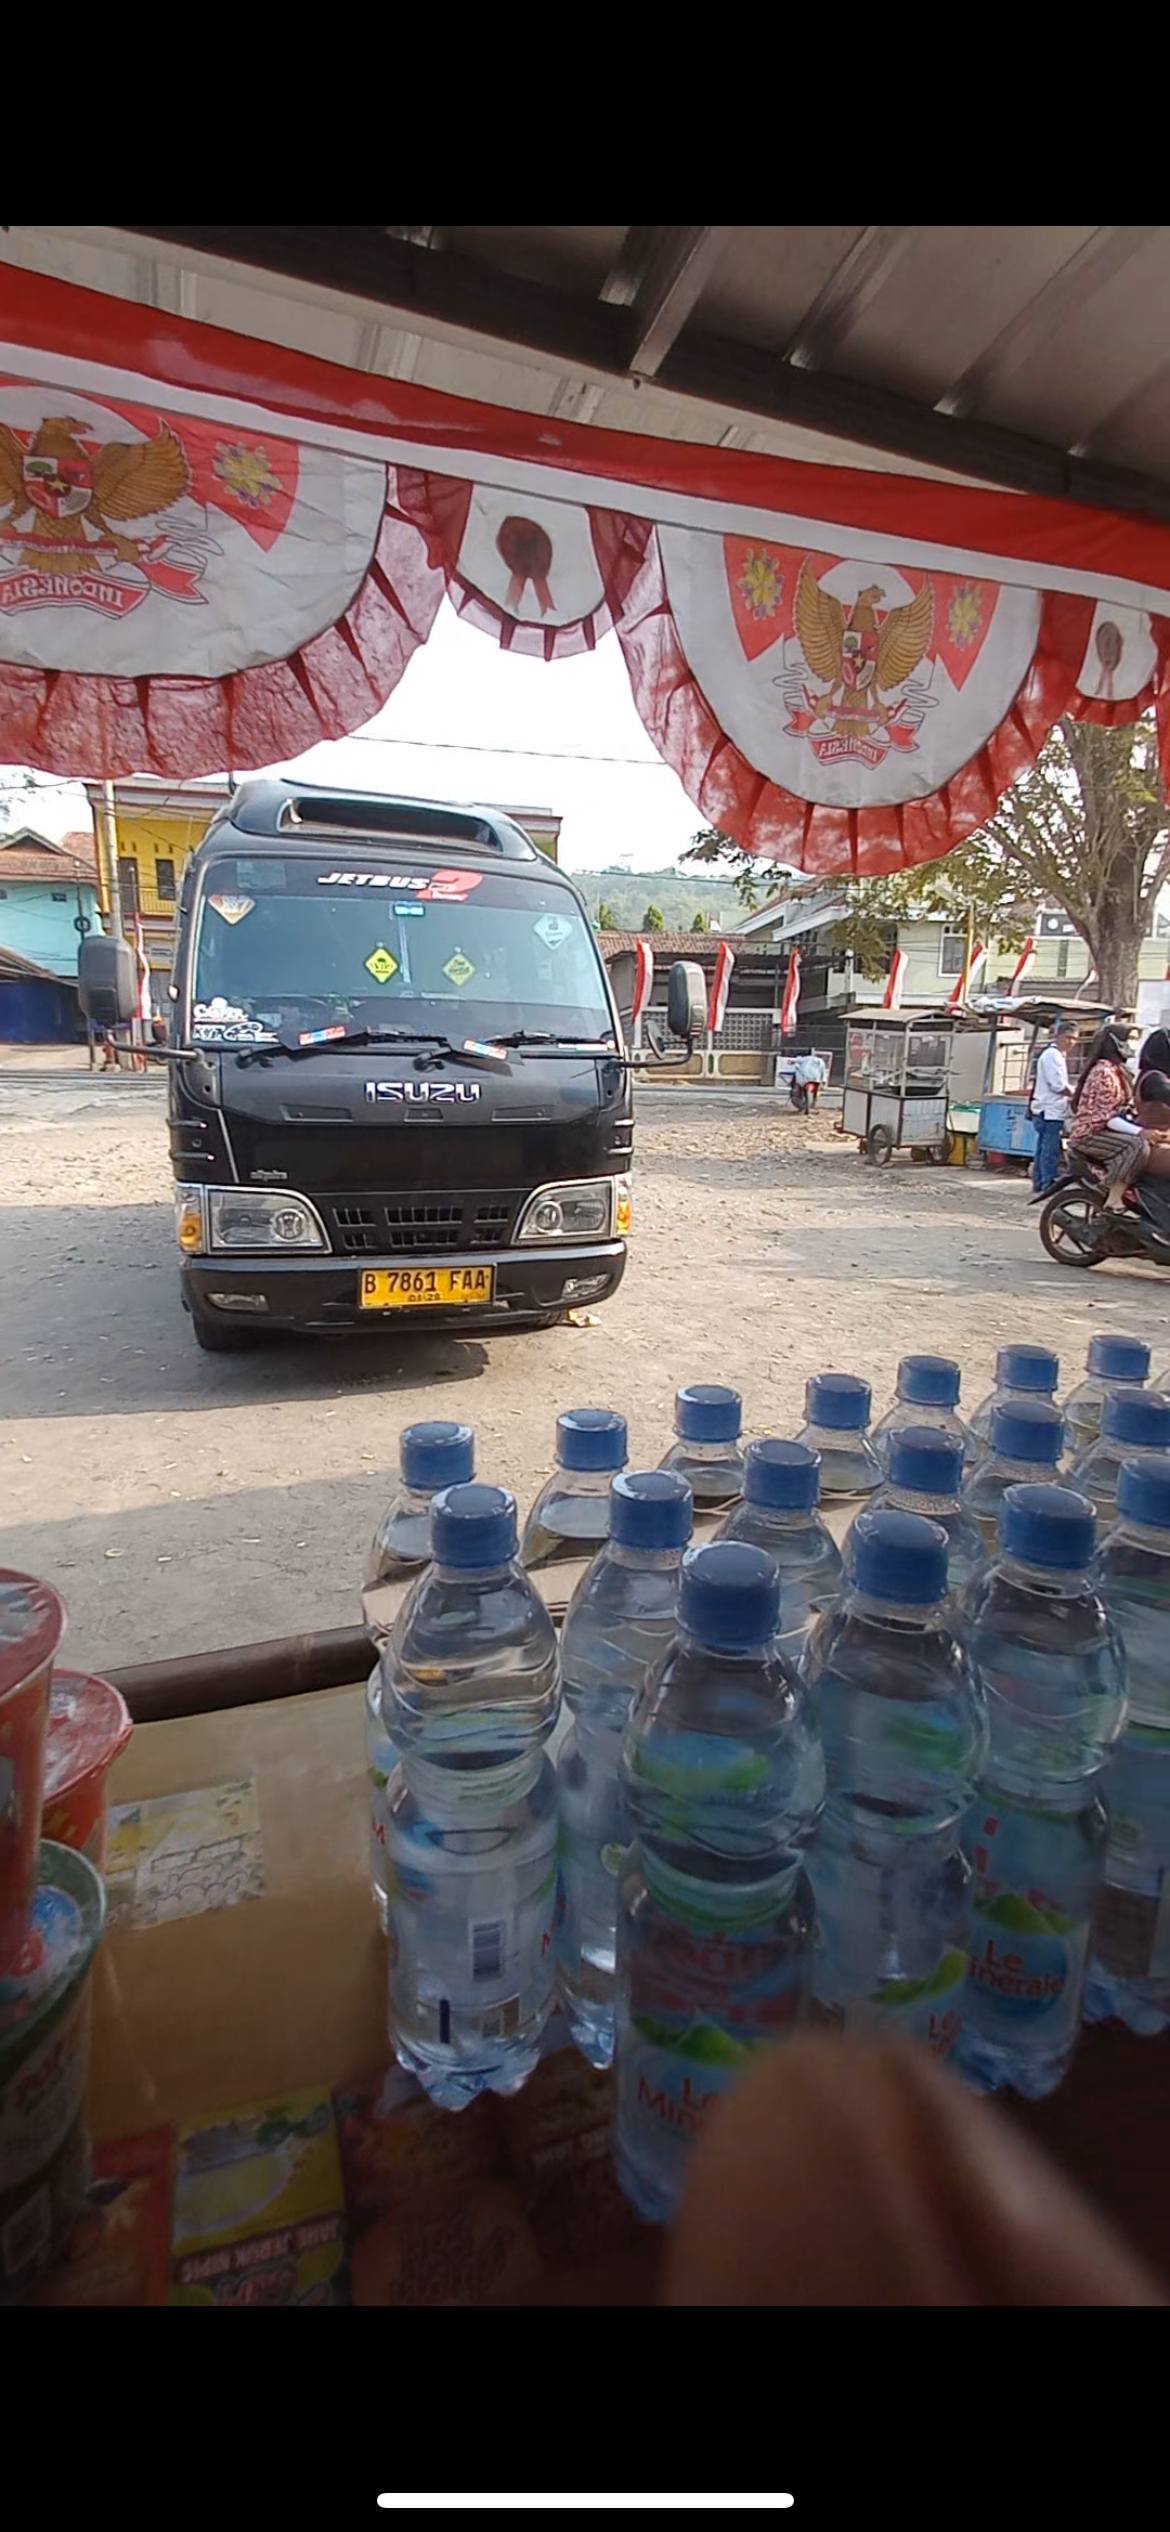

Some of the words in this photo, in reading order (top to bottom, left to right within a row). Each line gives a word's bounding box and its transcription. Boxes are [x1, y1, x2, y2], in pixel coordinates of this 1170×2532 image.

[317, 872, 430, 891] JETBUS
[365, 1081, 482, 1103] ISUZU
[364, 1273, 377, 1294] B
[387, 1271, 437, 1293] 7861
[450, 1269, 485, 1291] FAA
[969, 1956, 1066, 1997] inerale
